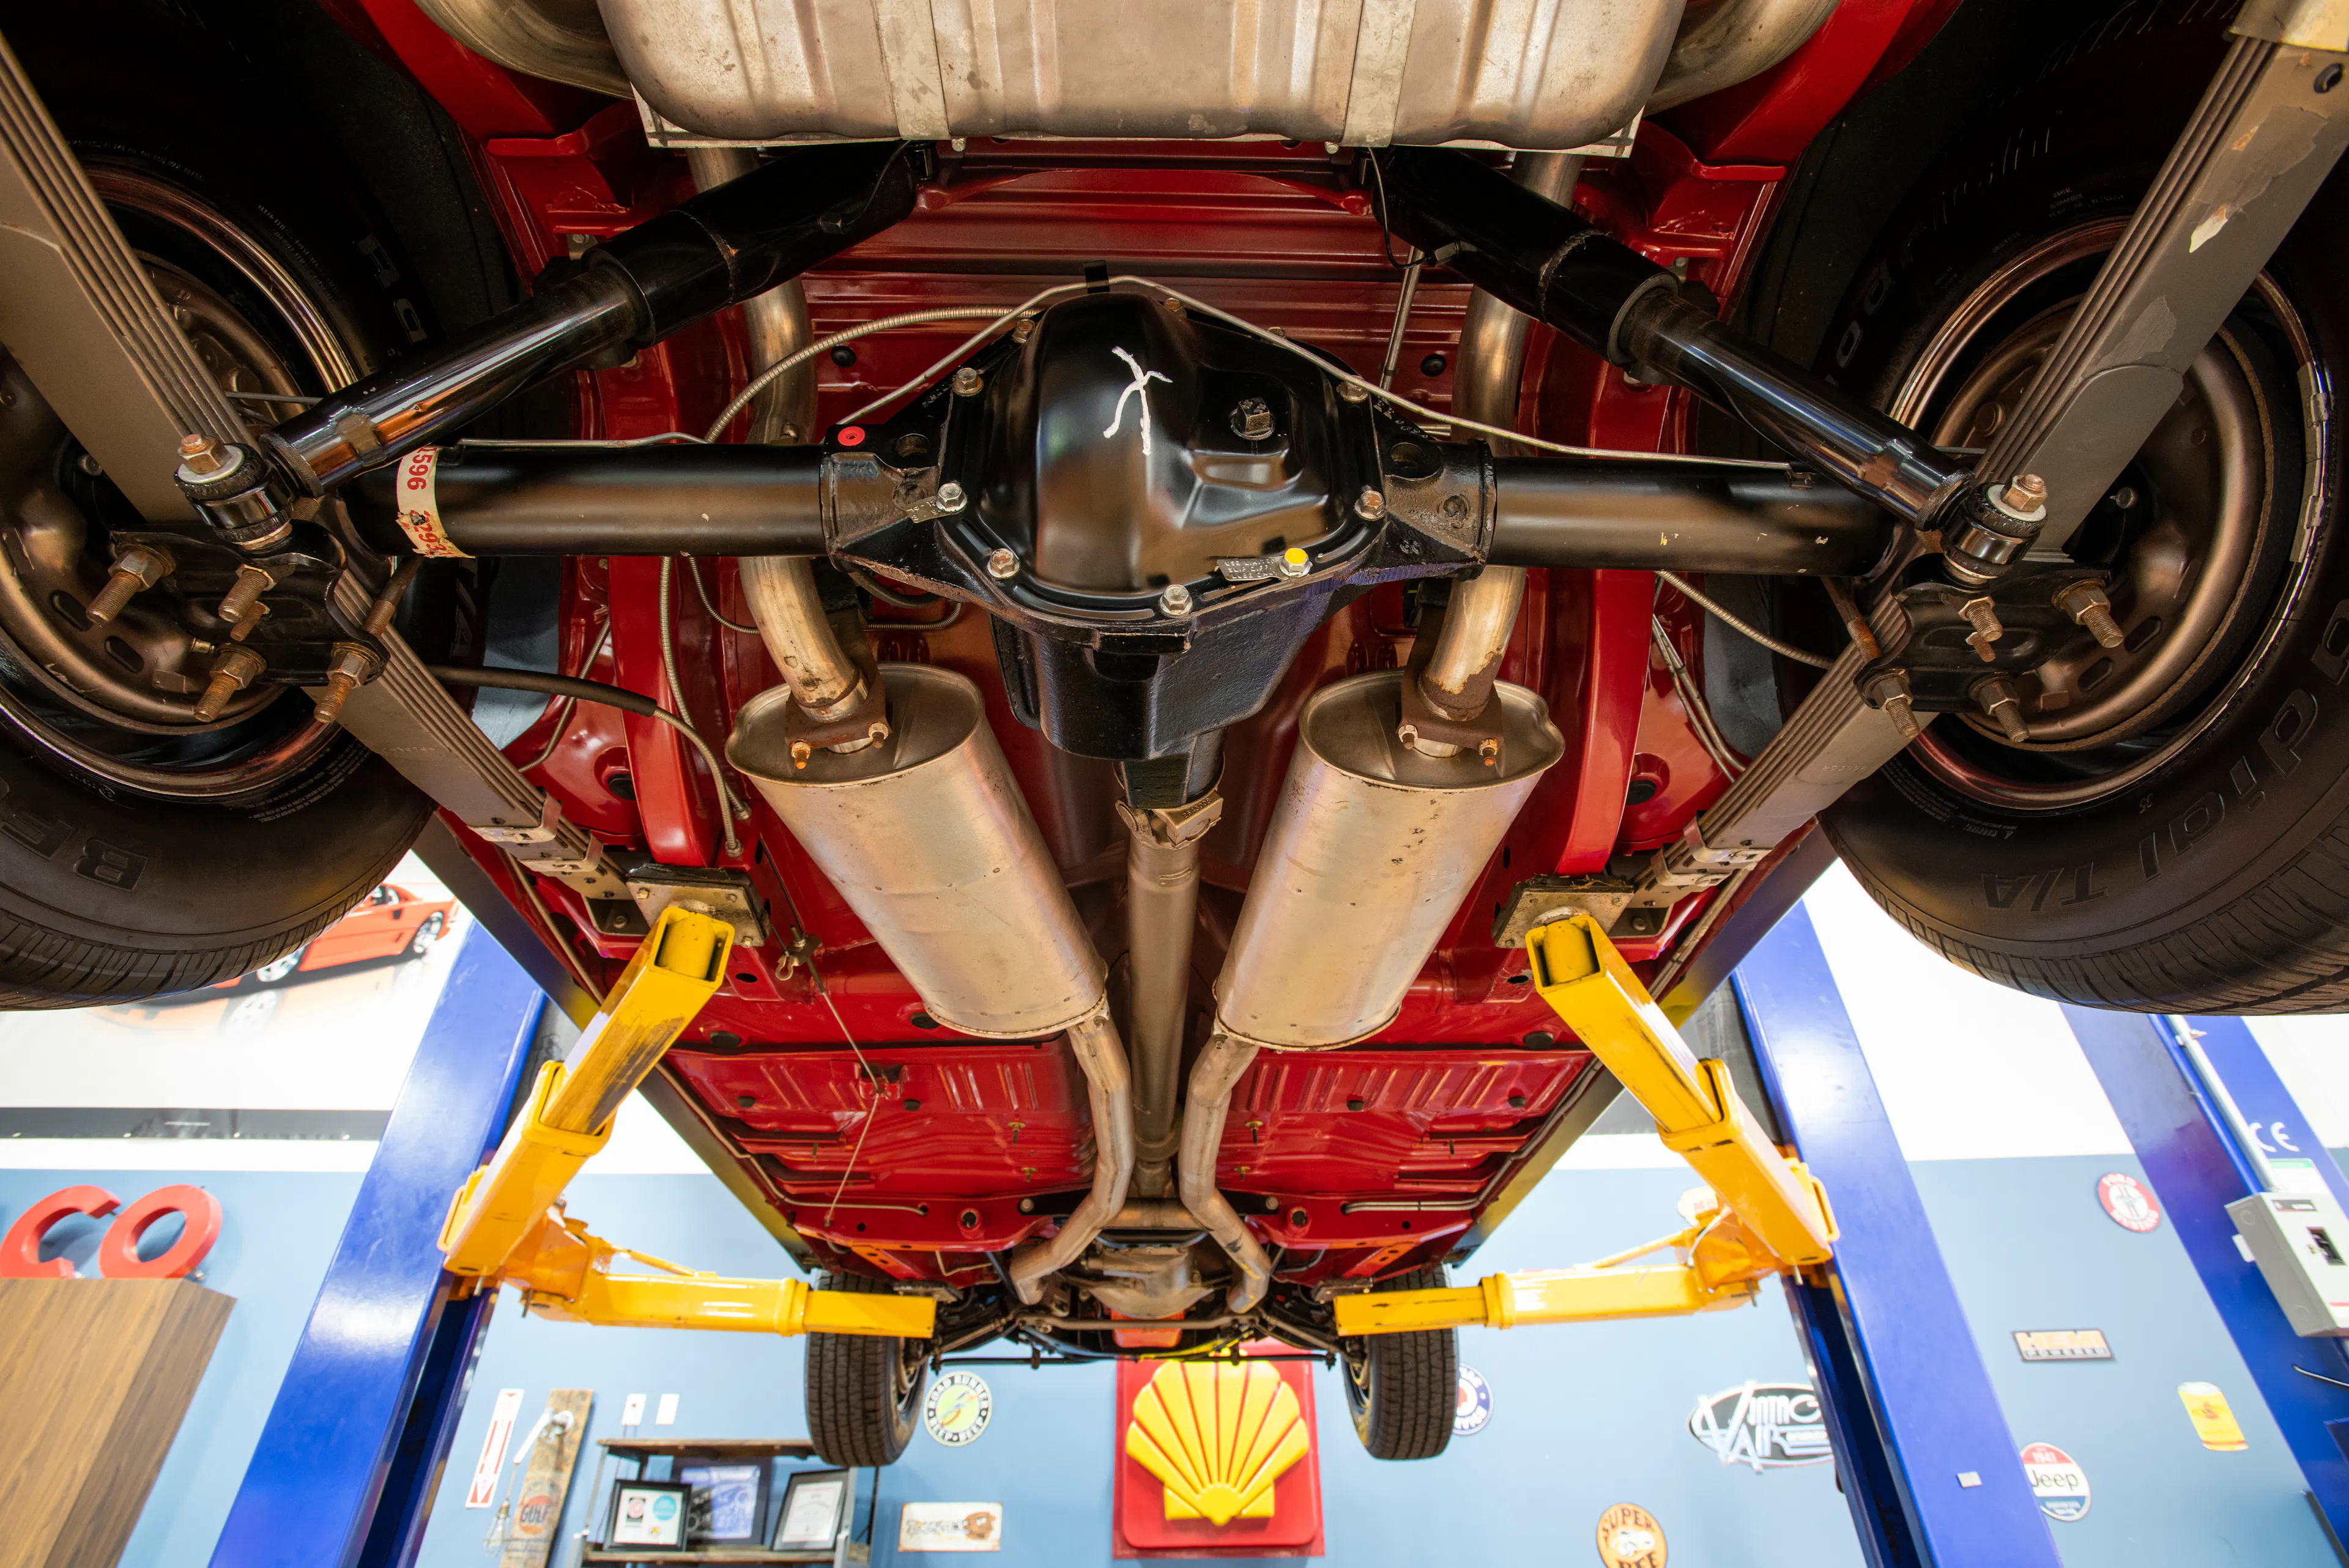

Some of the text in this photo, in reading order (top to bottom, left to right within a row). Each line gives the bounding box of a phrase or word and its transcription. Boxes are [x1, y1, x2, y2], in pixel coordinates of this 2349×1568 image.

[407, 447, 437, 491] 1596
[0, 776, 149, 893] BF
[1981, 861, 2109, 912] T/A
[2015, 1329, 2108, 1351] HEMI
[927, 1375, 989, 1410] ROAD RUNNER
[2031, 1468, 2079, 1492] Jeep
[1601, 1507, 1655, 1550] SUPER
